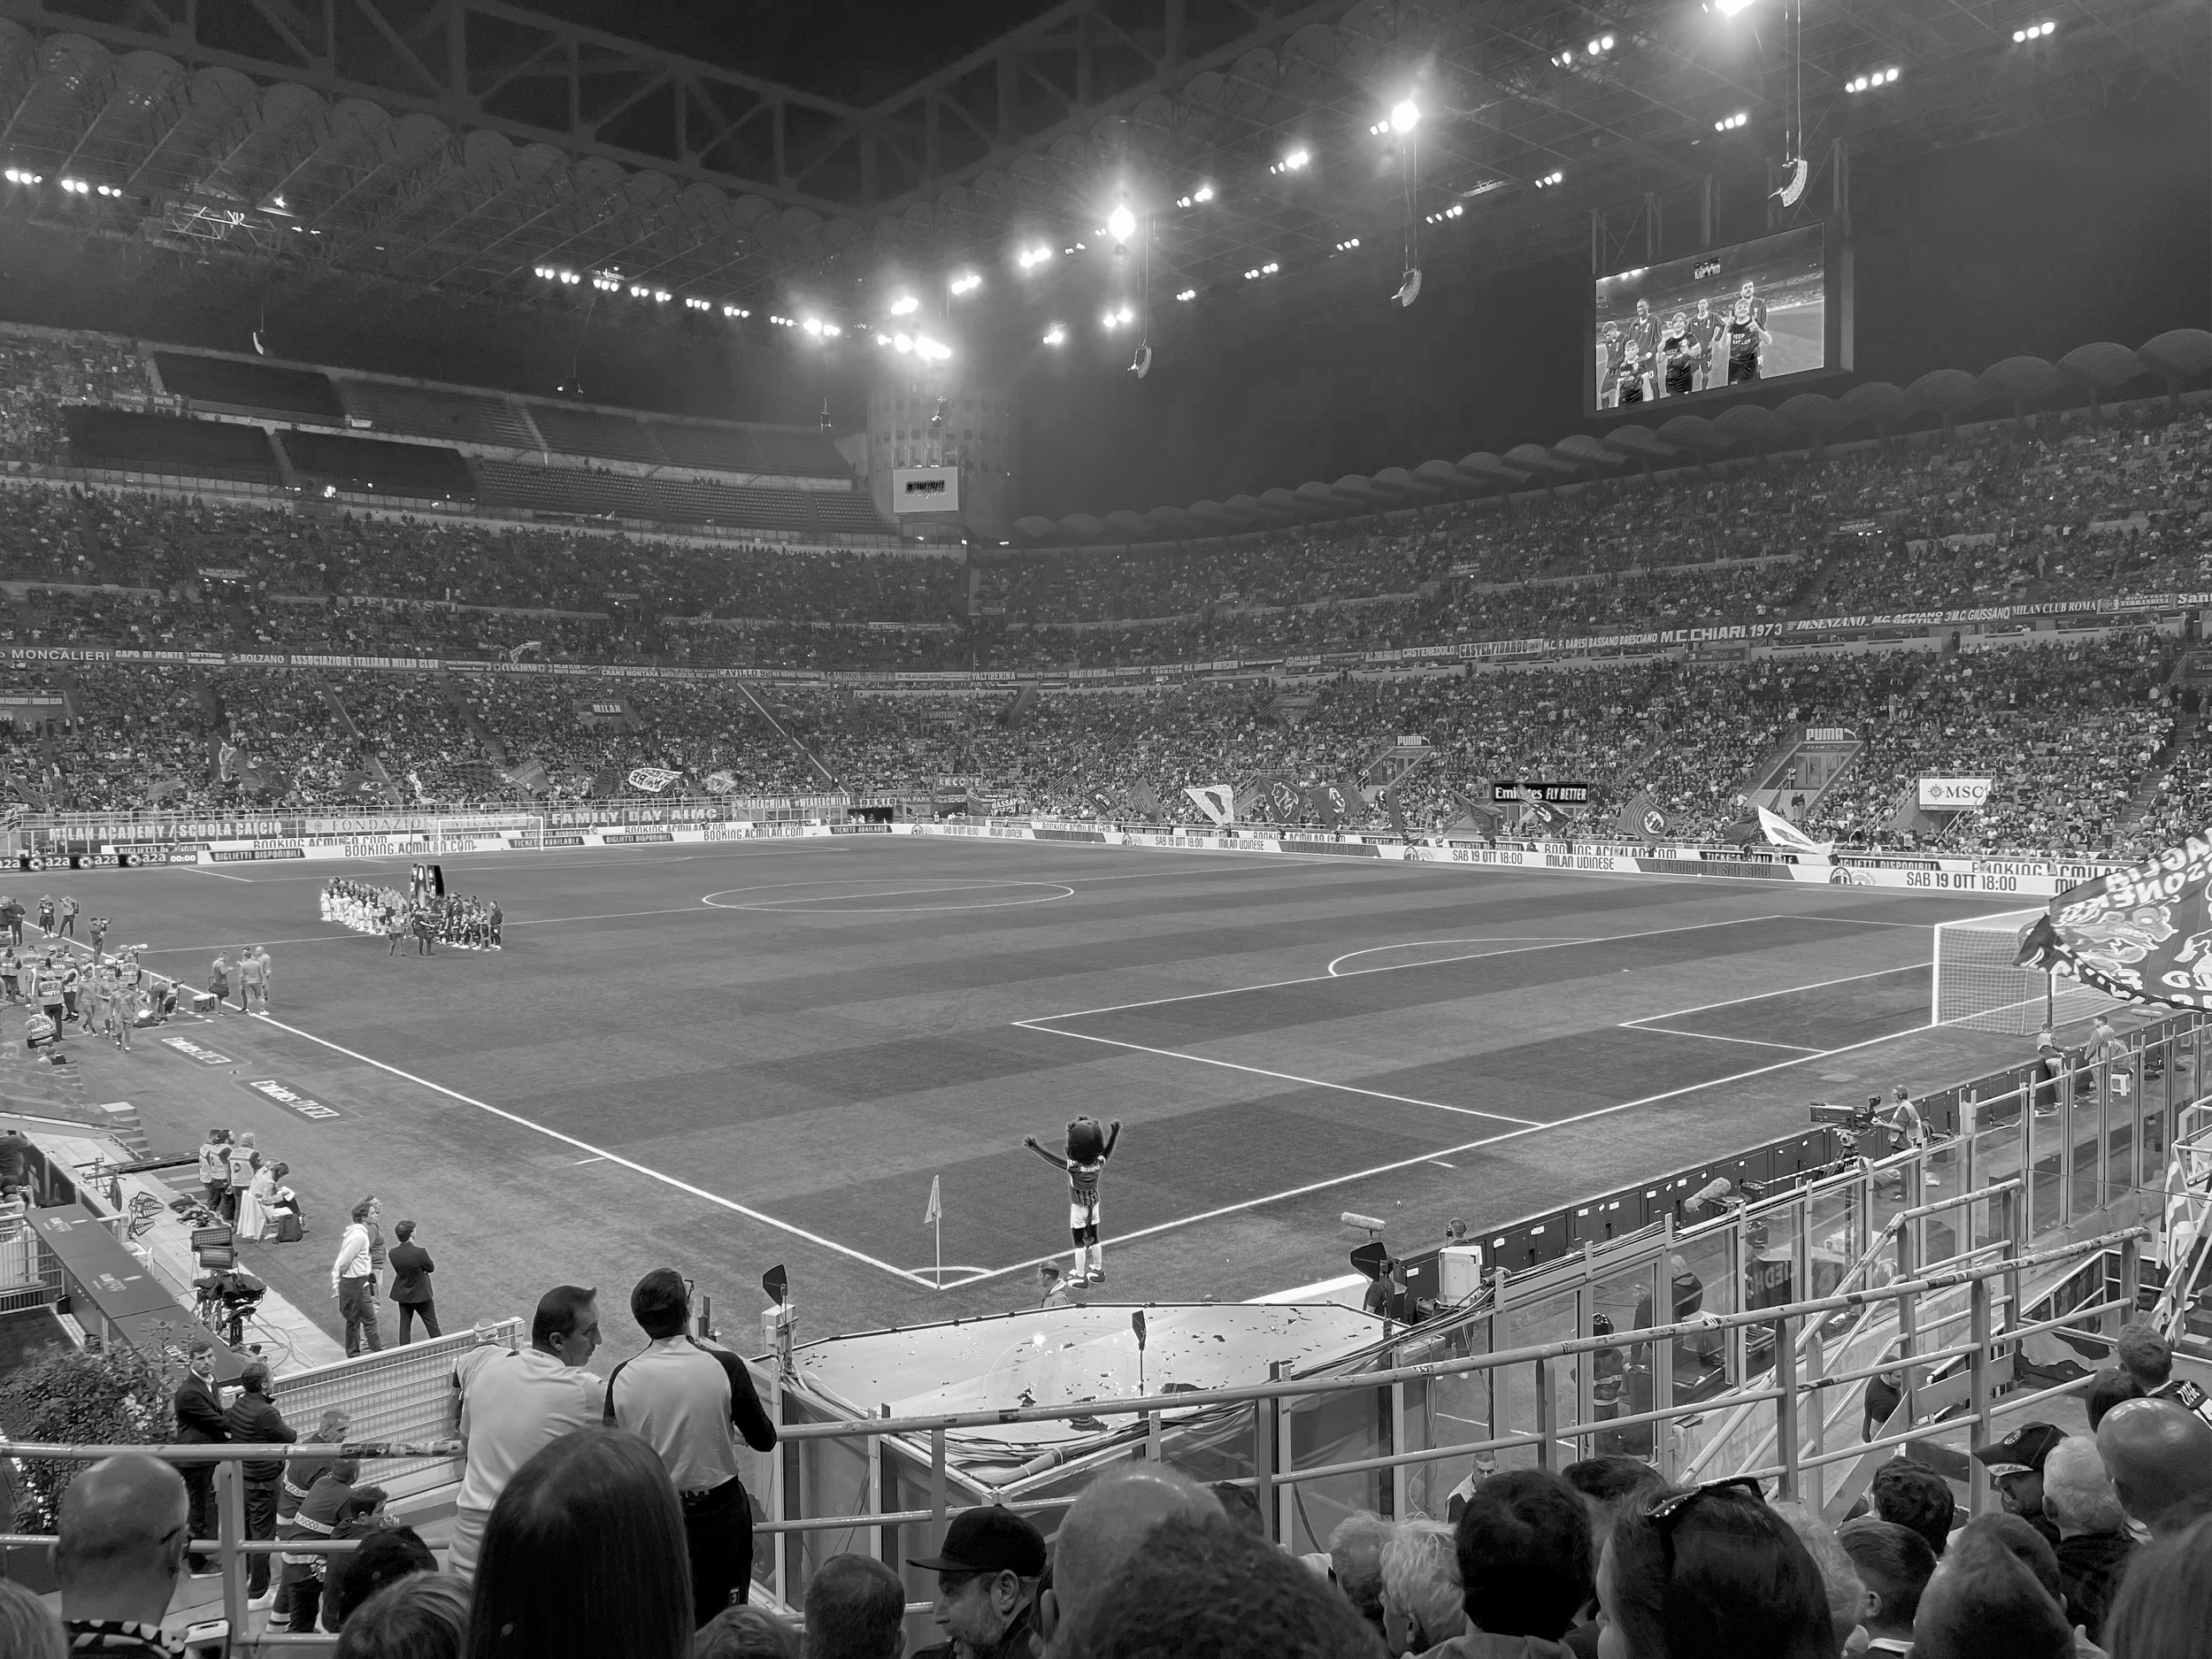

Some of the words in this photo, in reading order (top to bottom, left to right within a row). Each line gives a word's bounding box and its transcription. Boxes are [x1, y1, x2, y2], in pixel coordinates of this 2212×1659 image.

[352, 596, 457, 612] PELTASTI
[2012, 604, 2040, 616] MILAN
[2042, 603, 2067, 614] CLUB
[2069, 601, 2096, 612] ROMA
[1953, 610, 1966, 621] M.C.
[1968, 608, 2010, 621] GIUSSANO
[1750, 623, 1783, 637] 1973
[1543, 641, 1556, 650] M.C.
[1565, 638, 1587, 649] BARESI
[1588, 636, 1619, 647] BASSANO
[1619, 633, 1657, 645] BRESCIANO
[12, 649, 110, 661] MONCALIERI
[1402, 646, 1455, 658] CASTENEDOLO
[1460, 641, 1528, 657] CASTELFIDARDO
[240, 653, 284, 664] BOLZANO
[290, 655, 352, 666] ASSOCIAZIONE
[354, 657, 390, 667] ITALIANA
[392, 657, 418, 668] MILAN
[419, 658, 439, 669] CLUB
[501, 664, 538, 672] CUGGIONO
[972, 672, 1016, 681] VALTIBERINA
[594, 704, 621, 713] MILAN
[1806, 727, 1844, 741] PUMA
[1397, 735, 1422, 746] PUMA
[939, 778, 981, 787] ARCOE
[1546, 787, 1559, 800] FLY
[1560, 787, 1586, 800] BETTER
[1946, 785, 1984, 799] MSC
[451, 816, 503, 828] MILAN
[552, 811, 619, 825] FAMILY
[629, 810, 663, 822] DAY
[672, 808, 718, 821] AIMC
[98, 825, 165, 841] ACADEMY
[179, 823, 232, 837] SCUOLA
[236, 821, 282, 836] CALCIO
[704, 827, 803, 841] BOOKING.ACMILAN.COM
[857, 825, 888, 833] AVAILABLE
[544, 837, 580, 846] AVAILABLE
[606, 834, 634, 843] BIGLIETTI
[635, 833, 671, 842] DISPONIBILI
[1155, 835, 1167, 846] SAB
[1168, 836, 1174, 846] 19
[1175, 836, 1187, 847] OTT
[1187, 837, 1203, 848] 18:00
[345, 840, 474, 857] BOOKING.ACMILAN.COM
[1219, 839, 1238, 849] MILAN
[1239, 840, 1264, 851] UDINESE
[94, 855, 119, 865] a2a
[142, 853, 167, 863] a2a
[170, 854, 196, 863] 00:00
[214, 850, 252, 861] BIGLIETTI
[254, 849, 302, 859] DISPONIBILI
[1453, 849, 1469, 863] SAB
[1471, 850, 1480, 862] 19
[1482, 850, 1497, 864] OTT
[1499, 851, 1523, 865] 18:00
[45, 856, 71, 867] a2a
[1546, 854, 1574, 868] MILAN
[1577, 856, 1615, 871] UDINESE
[1653, 859, 1664, 872] CI
[1666, 861, 1709, 876] VEDIAMO
[1712, 863, 1721, 875] A
[1722, 863, 1743, 876] SAN
[1746, 864, 1773, 879] SIRO!
[1906, 872, 1932, 887] SAB
[1935, 873, 1948, 887] 19
[1953, 873, 1977, 889] OTT
[1981, 875, 2016, 891] 18:00
[29, 1018, 47, 1027] 024
[31, 1024, 51, 1034] PHOTO
[299, 1517, 319, 1530] FUOCO
